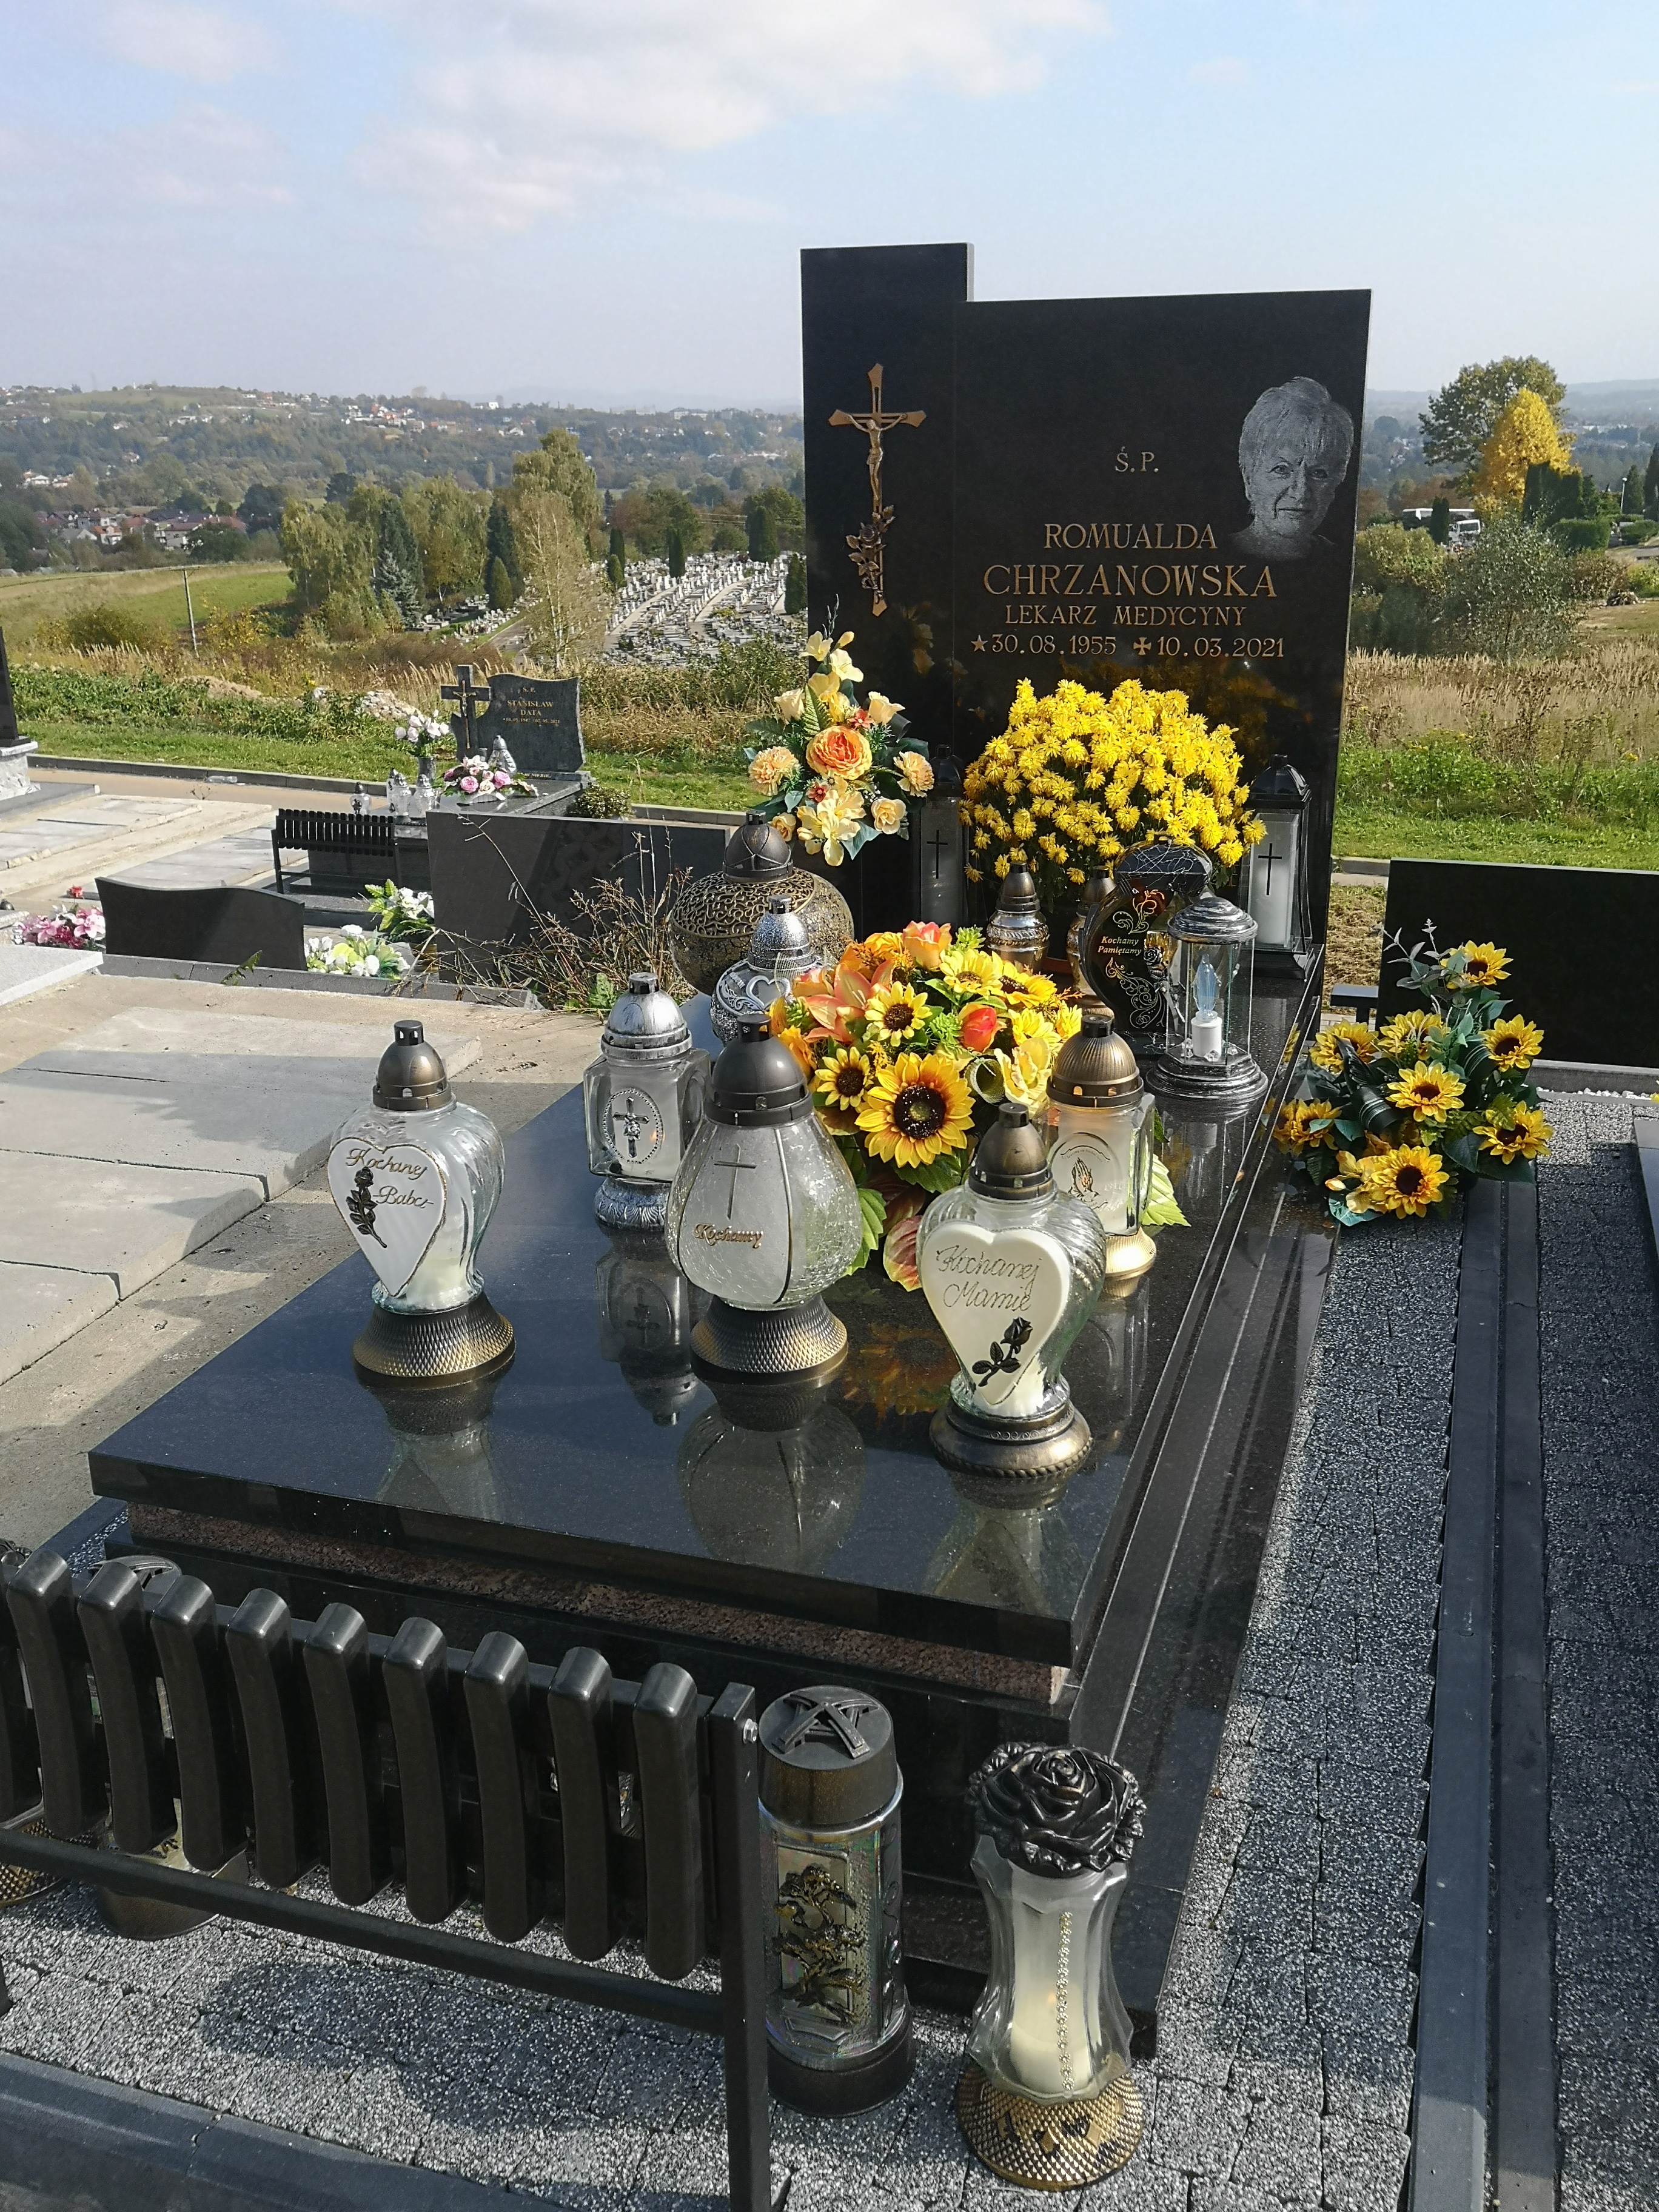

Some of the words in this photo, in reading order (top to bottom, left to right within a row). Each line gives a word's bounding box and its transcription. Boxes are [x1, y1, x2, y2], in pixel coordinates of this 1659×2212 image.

[1044, 523, 1218, 549] ROMUALDA
[983, 564, 1278, 597] CHRZANOWSKA
[1005, 605, 1098, 625] LEKARZ
[1112, 606, 1247, 626] MEDYCYNY
[1098, 946, 1142, 956] Pamiętamy
[1101, 936, 1139, 946] Kochamy
[936, 1245, 1042, 1294] Kochanej
[943, 1281, 1032, 1312] Mamie
